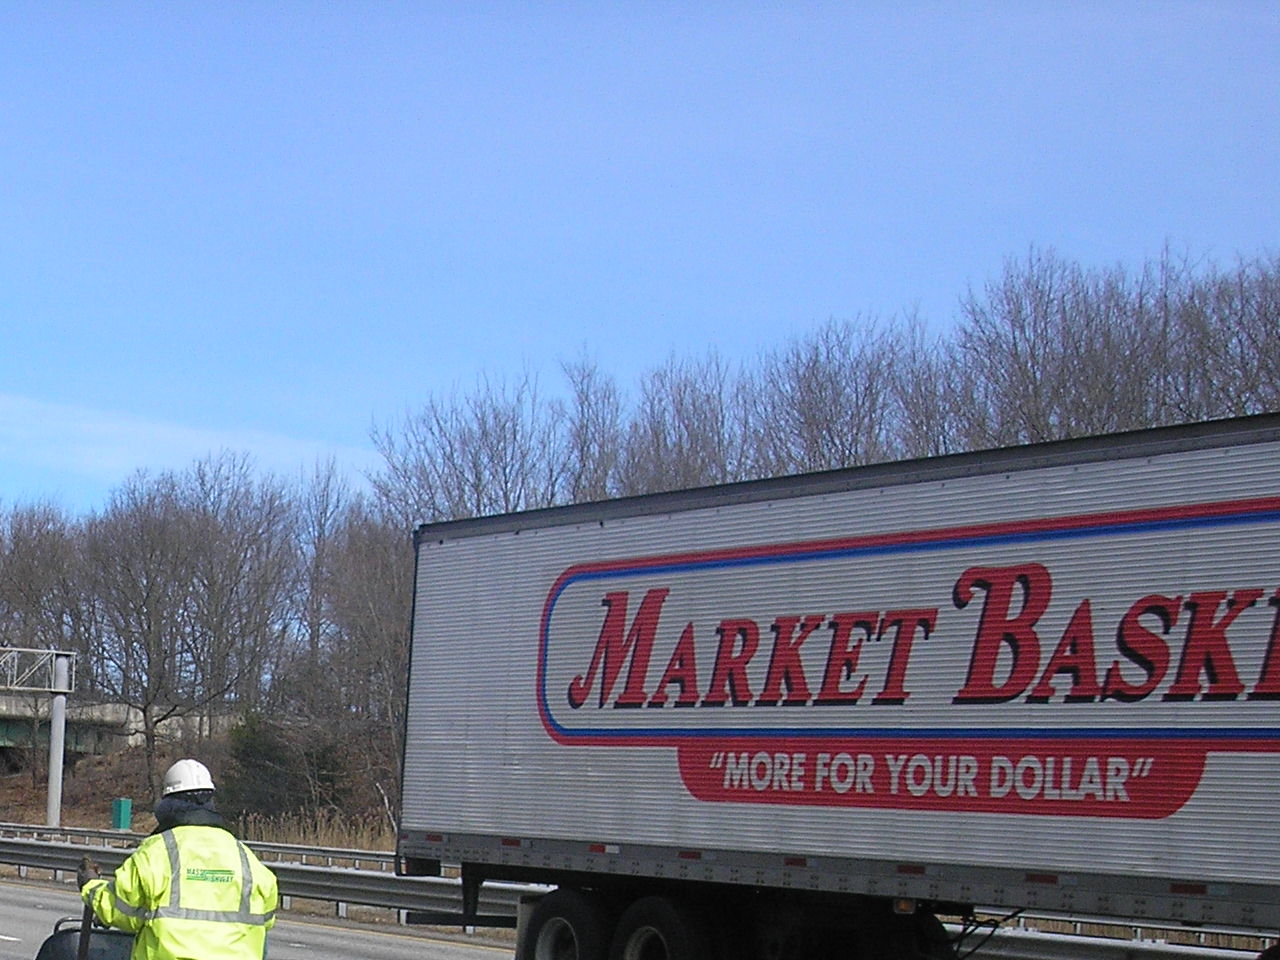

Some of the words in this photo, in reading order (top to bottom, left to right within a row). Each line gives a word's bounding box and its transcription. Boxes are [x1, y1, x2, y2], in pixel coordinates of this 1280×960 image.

[567, 587, 938, 709] MARKET
[709, 751, 806, 792] "MORE
[815, 752, 875, 794] FOR
[885, 753, 979, 798] YOUR
[989, 754, 1155, 801] DOLLAR"
